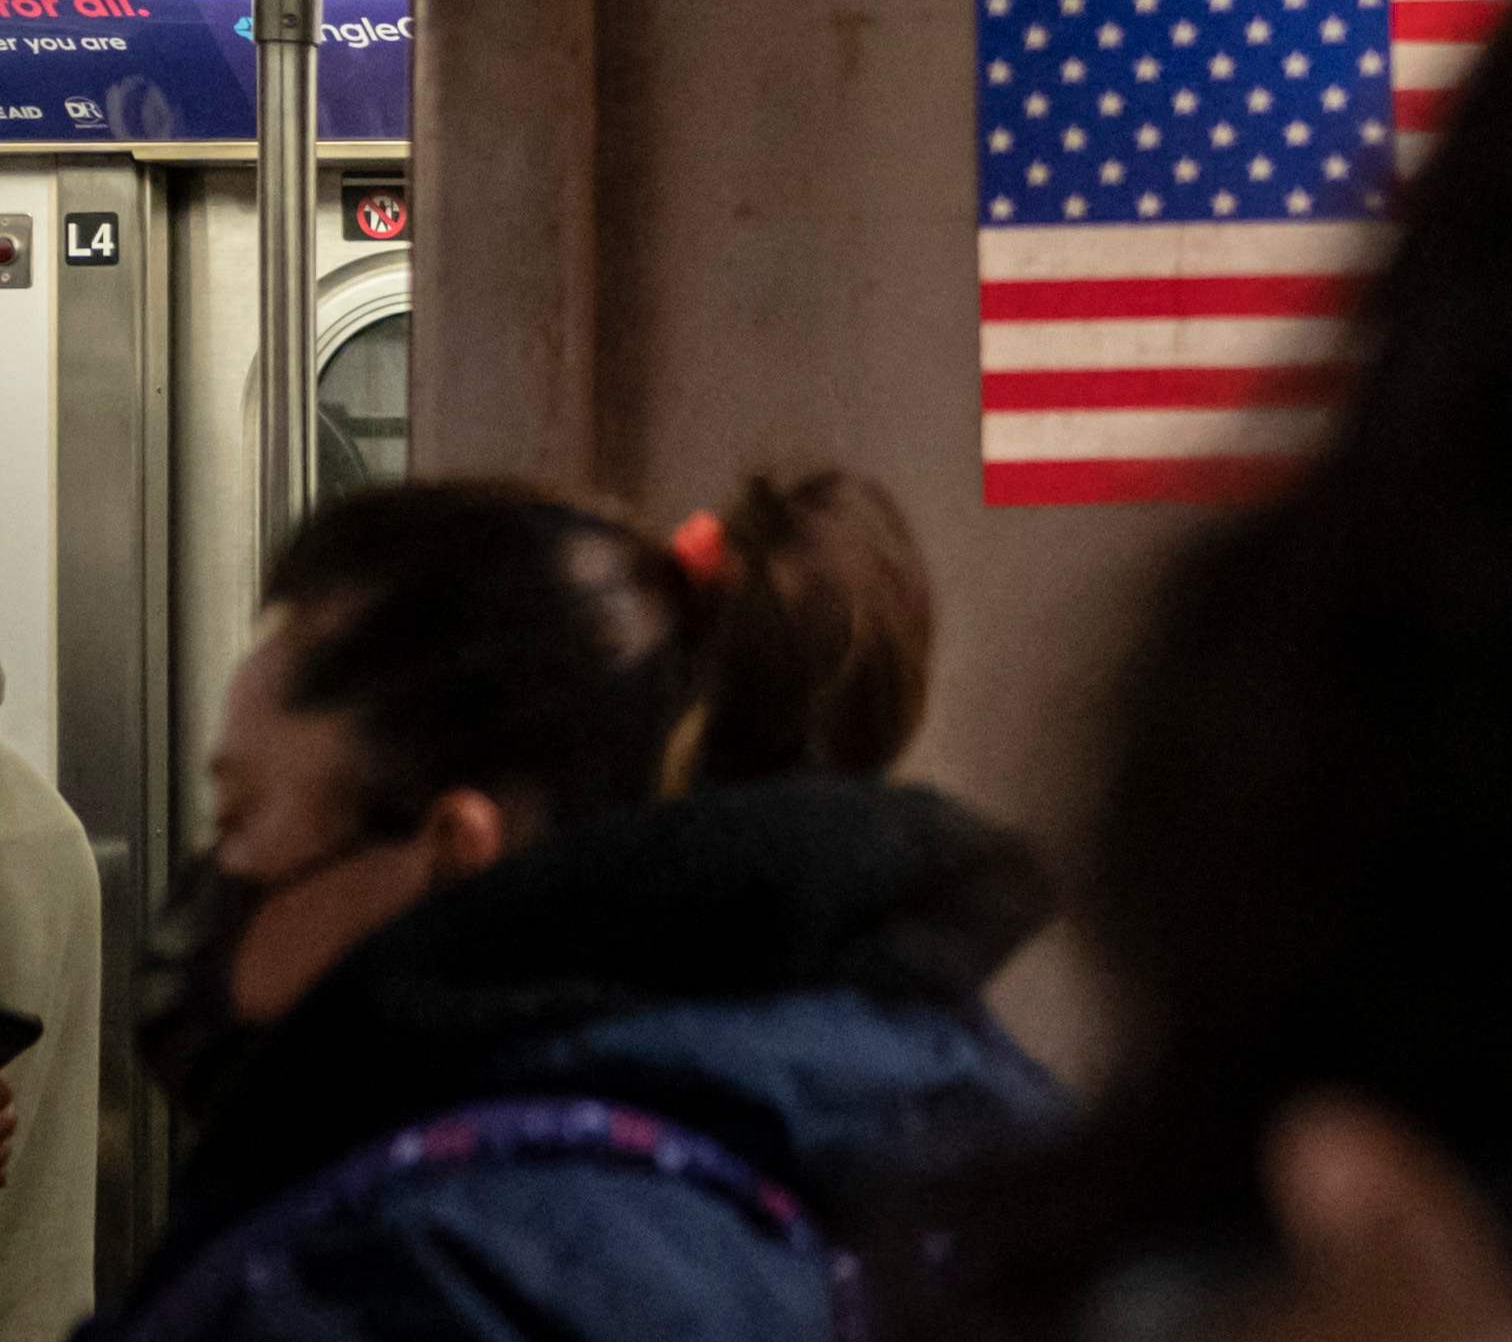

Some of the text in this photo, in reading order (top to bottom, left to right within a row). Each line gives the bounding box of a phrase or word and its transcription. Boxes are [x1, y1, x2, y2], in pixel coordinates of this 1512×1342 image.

[23, 37, 78, 55] you
[80, 37, 127, 51] are
[68, 222, 114, 257] L4
